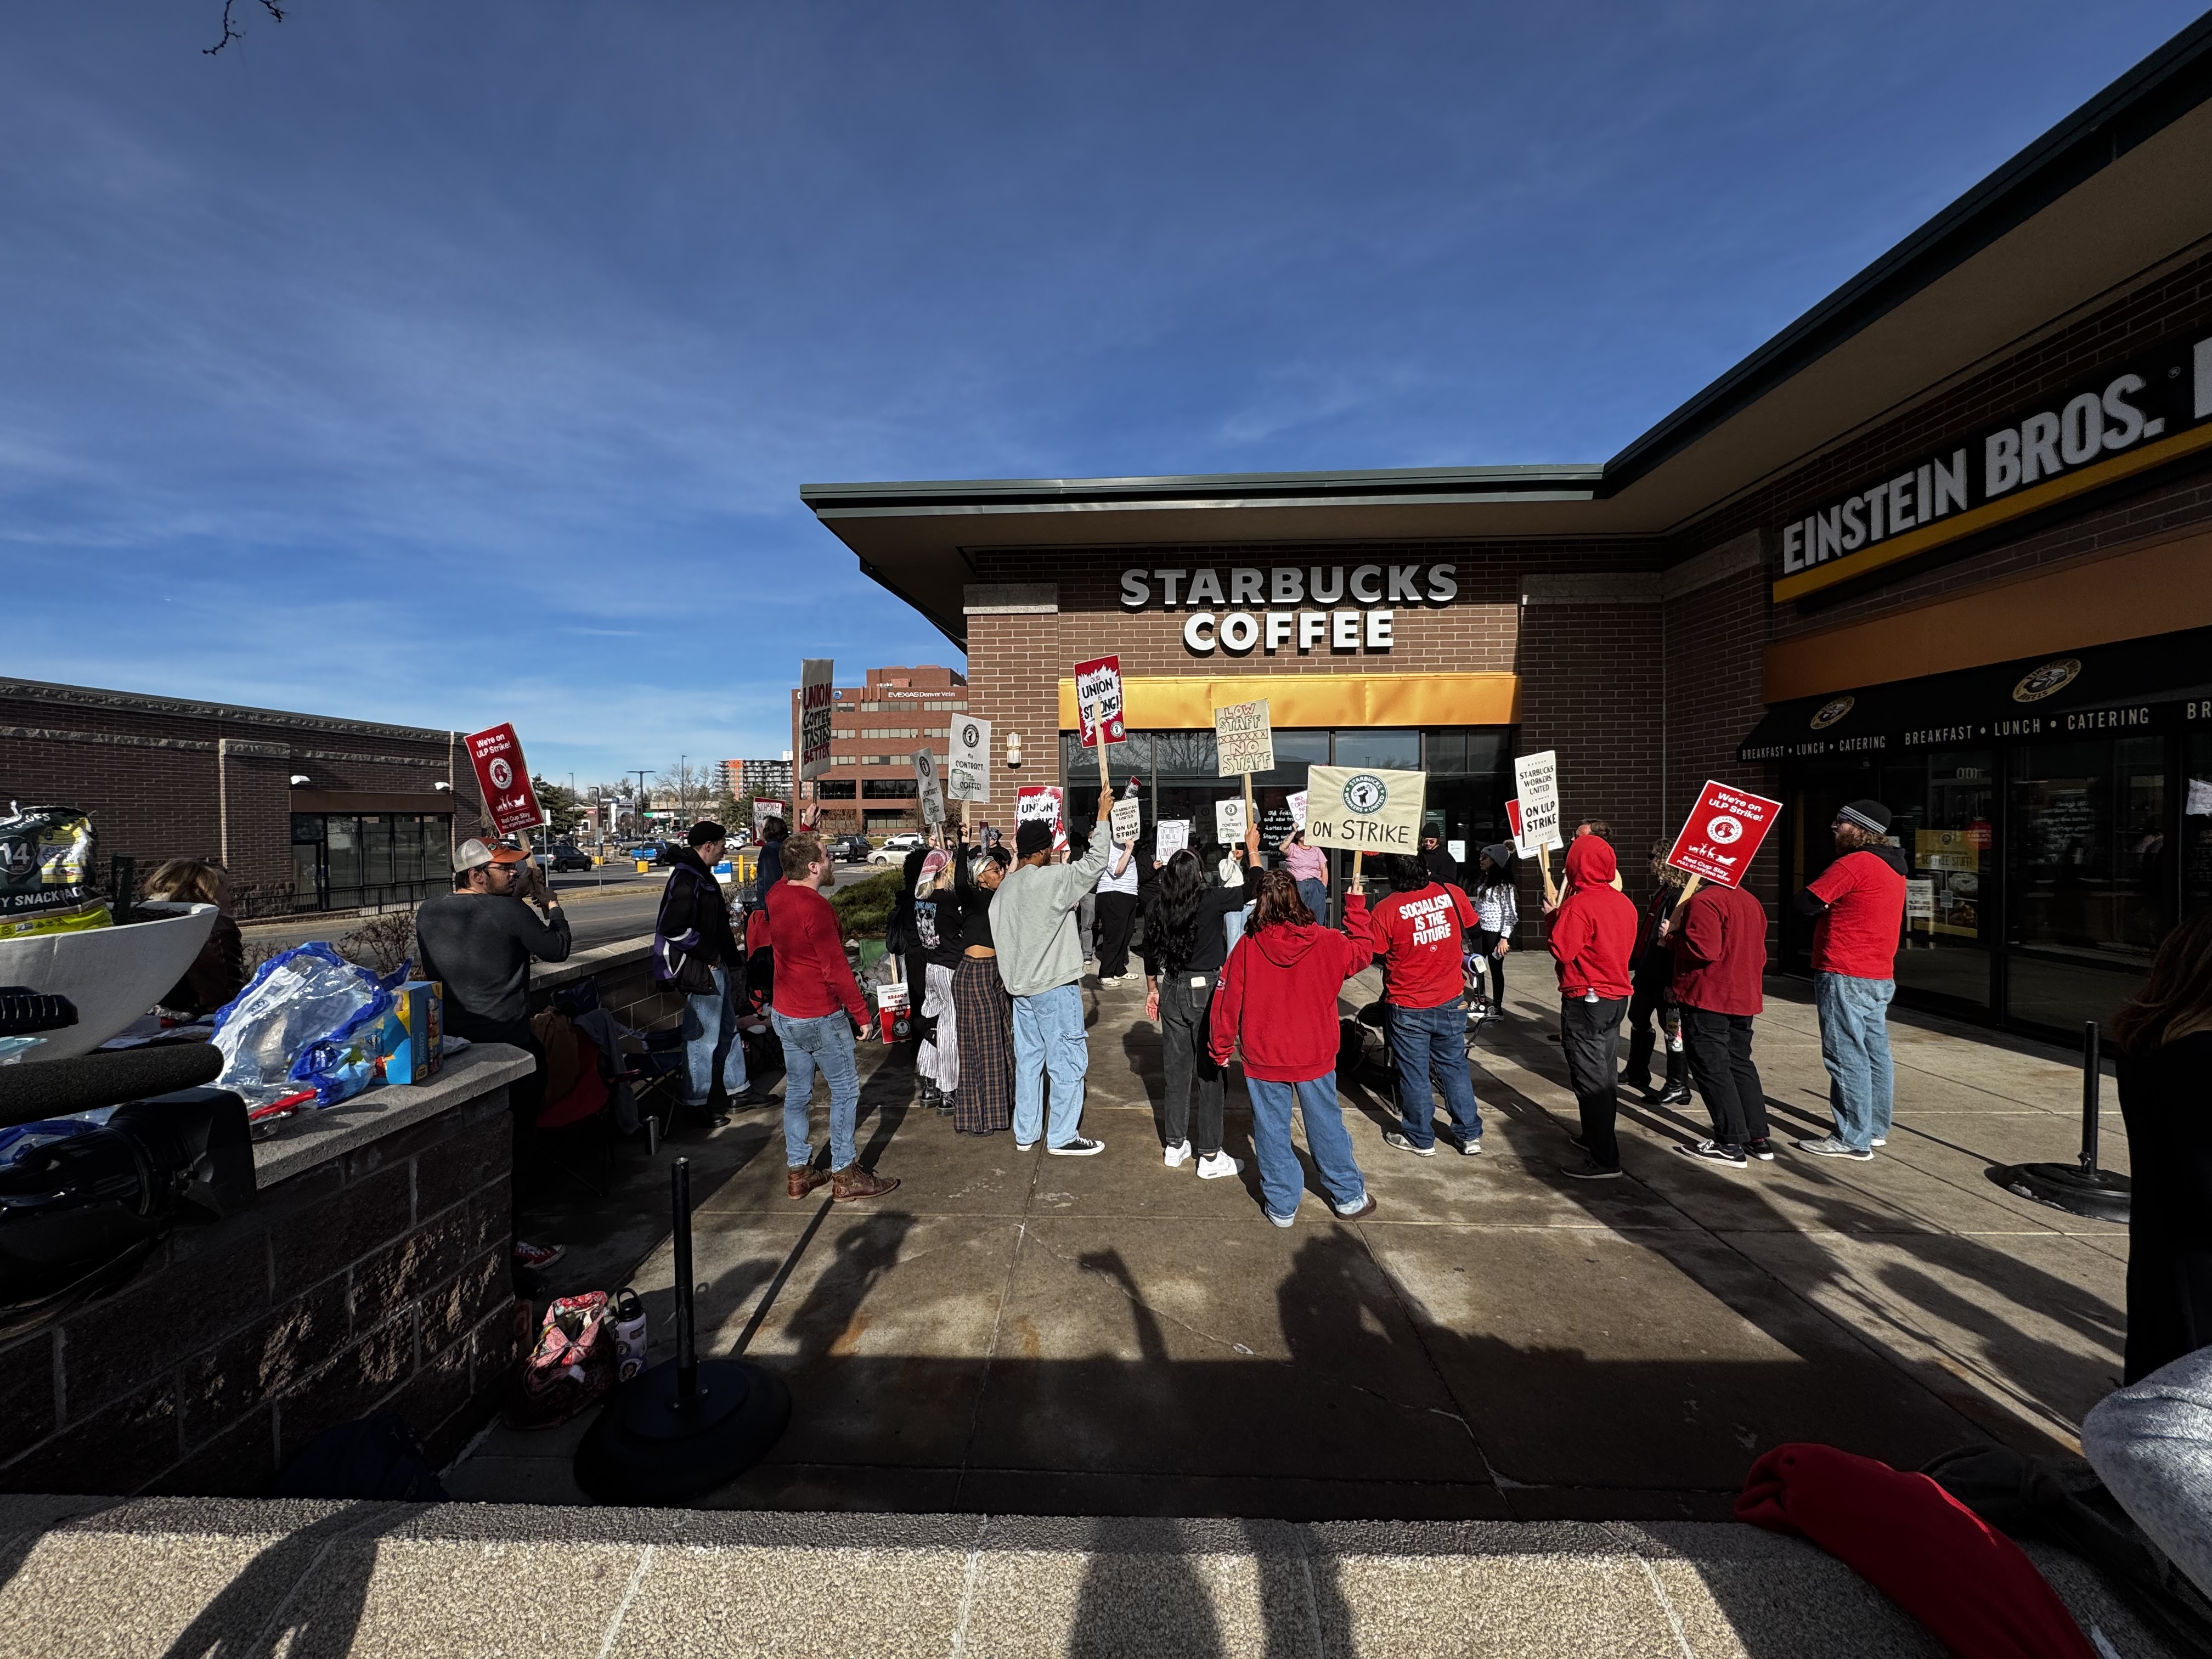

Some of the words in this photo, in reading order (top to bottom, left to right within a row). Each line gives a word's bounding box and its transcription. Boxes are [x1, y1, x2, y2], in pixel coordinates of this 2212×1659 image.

[1784, 448, 1967, 574] EINSTEIN
[1985, 374, 2165, 498] BROS.
[1121, 564, 1458, 606] STARBUCKS
[1184, 610, 1394, 651] COFFEE
[1082, 678, 1114, 699] UNION
[1090, 675, 1101, 684] OUR
[803, 682, 832, 710] UNION
[1084, 695, 1119, 720] STONG!
[1224, 703, 1256, 718] LOW
[803, 707, 832, 729] COFFEE
[1219, 714, 1261, 733] STAFF
[1905, 725, 1973, 745] BREAKFAST
[1995, 718, 2040, 736] LUNCH
[2068, 708, 2149, 730] CATERING
[496, 733, 505, 742] on
[803, 721, 831, 749] TASTES
[476, 749, 488, 758] ULP
[489, 741, 511, 754] Strike!
[804, 742, 830, 765] BETTER
[1230, 741, 1259, 755] NO
[1742, 746, 1784, 760] BREAKFAST
[1797, 742, 1824, 755] LUNCH
[1839, 736, 1886, 751] CATERING
[1223, 751, 1271, 775] STAFF
[1519, 765, 1554, 780] STARBUCKS
[1349, 776, 1383, 789] STARBUCKS
[1523, 774, 1552, 787] WORKERS
[1530, 784, 1549, 795] UNITED
[757, 803, 780, 812] RIGHTS
[1022, 803, 1053, 813] UNON
[1113, 804, 1137, 814] STARBUCKS
[1344, 792, 1363, 812] WORKERS
[1368, 795, 1385, 811] UNITED
[1526, 805, 1539, 817] ON
[1541, 800, 1555, 814] ULP
[1708, 798, 1729, 809] ULP
[1729, 805, 1764, 822] Strike!
[1718, 792, 1747, 807] We're
[1748, 803, 1762, 812] on
[1313, 821, 1331, 838] ON
[1341, 819, 1410, 844] STRIKE
[1527, 813, 1556, 832] STRIKE
[1116, 828, 1139, 838] STRIKE
[1677, 859, 1689, 867] FULL
[1716, 874, 1731, 882] NOW
[1683, 855, 1698, 865] Red
[1697, 860, 1712, 871] Cup
[1713, 866, 1728, 877] Slay
[15, 891, 60, 906] SNACK
[1399, 894, 1453, 919] SOCIALISM
[1414, 916, 1426, 931] IS
[1425, 910, 1447, 928] THE
[1413, 923, 1451, 946] FUTURE
[884, 1005, 911, 1013] ONTRACT
